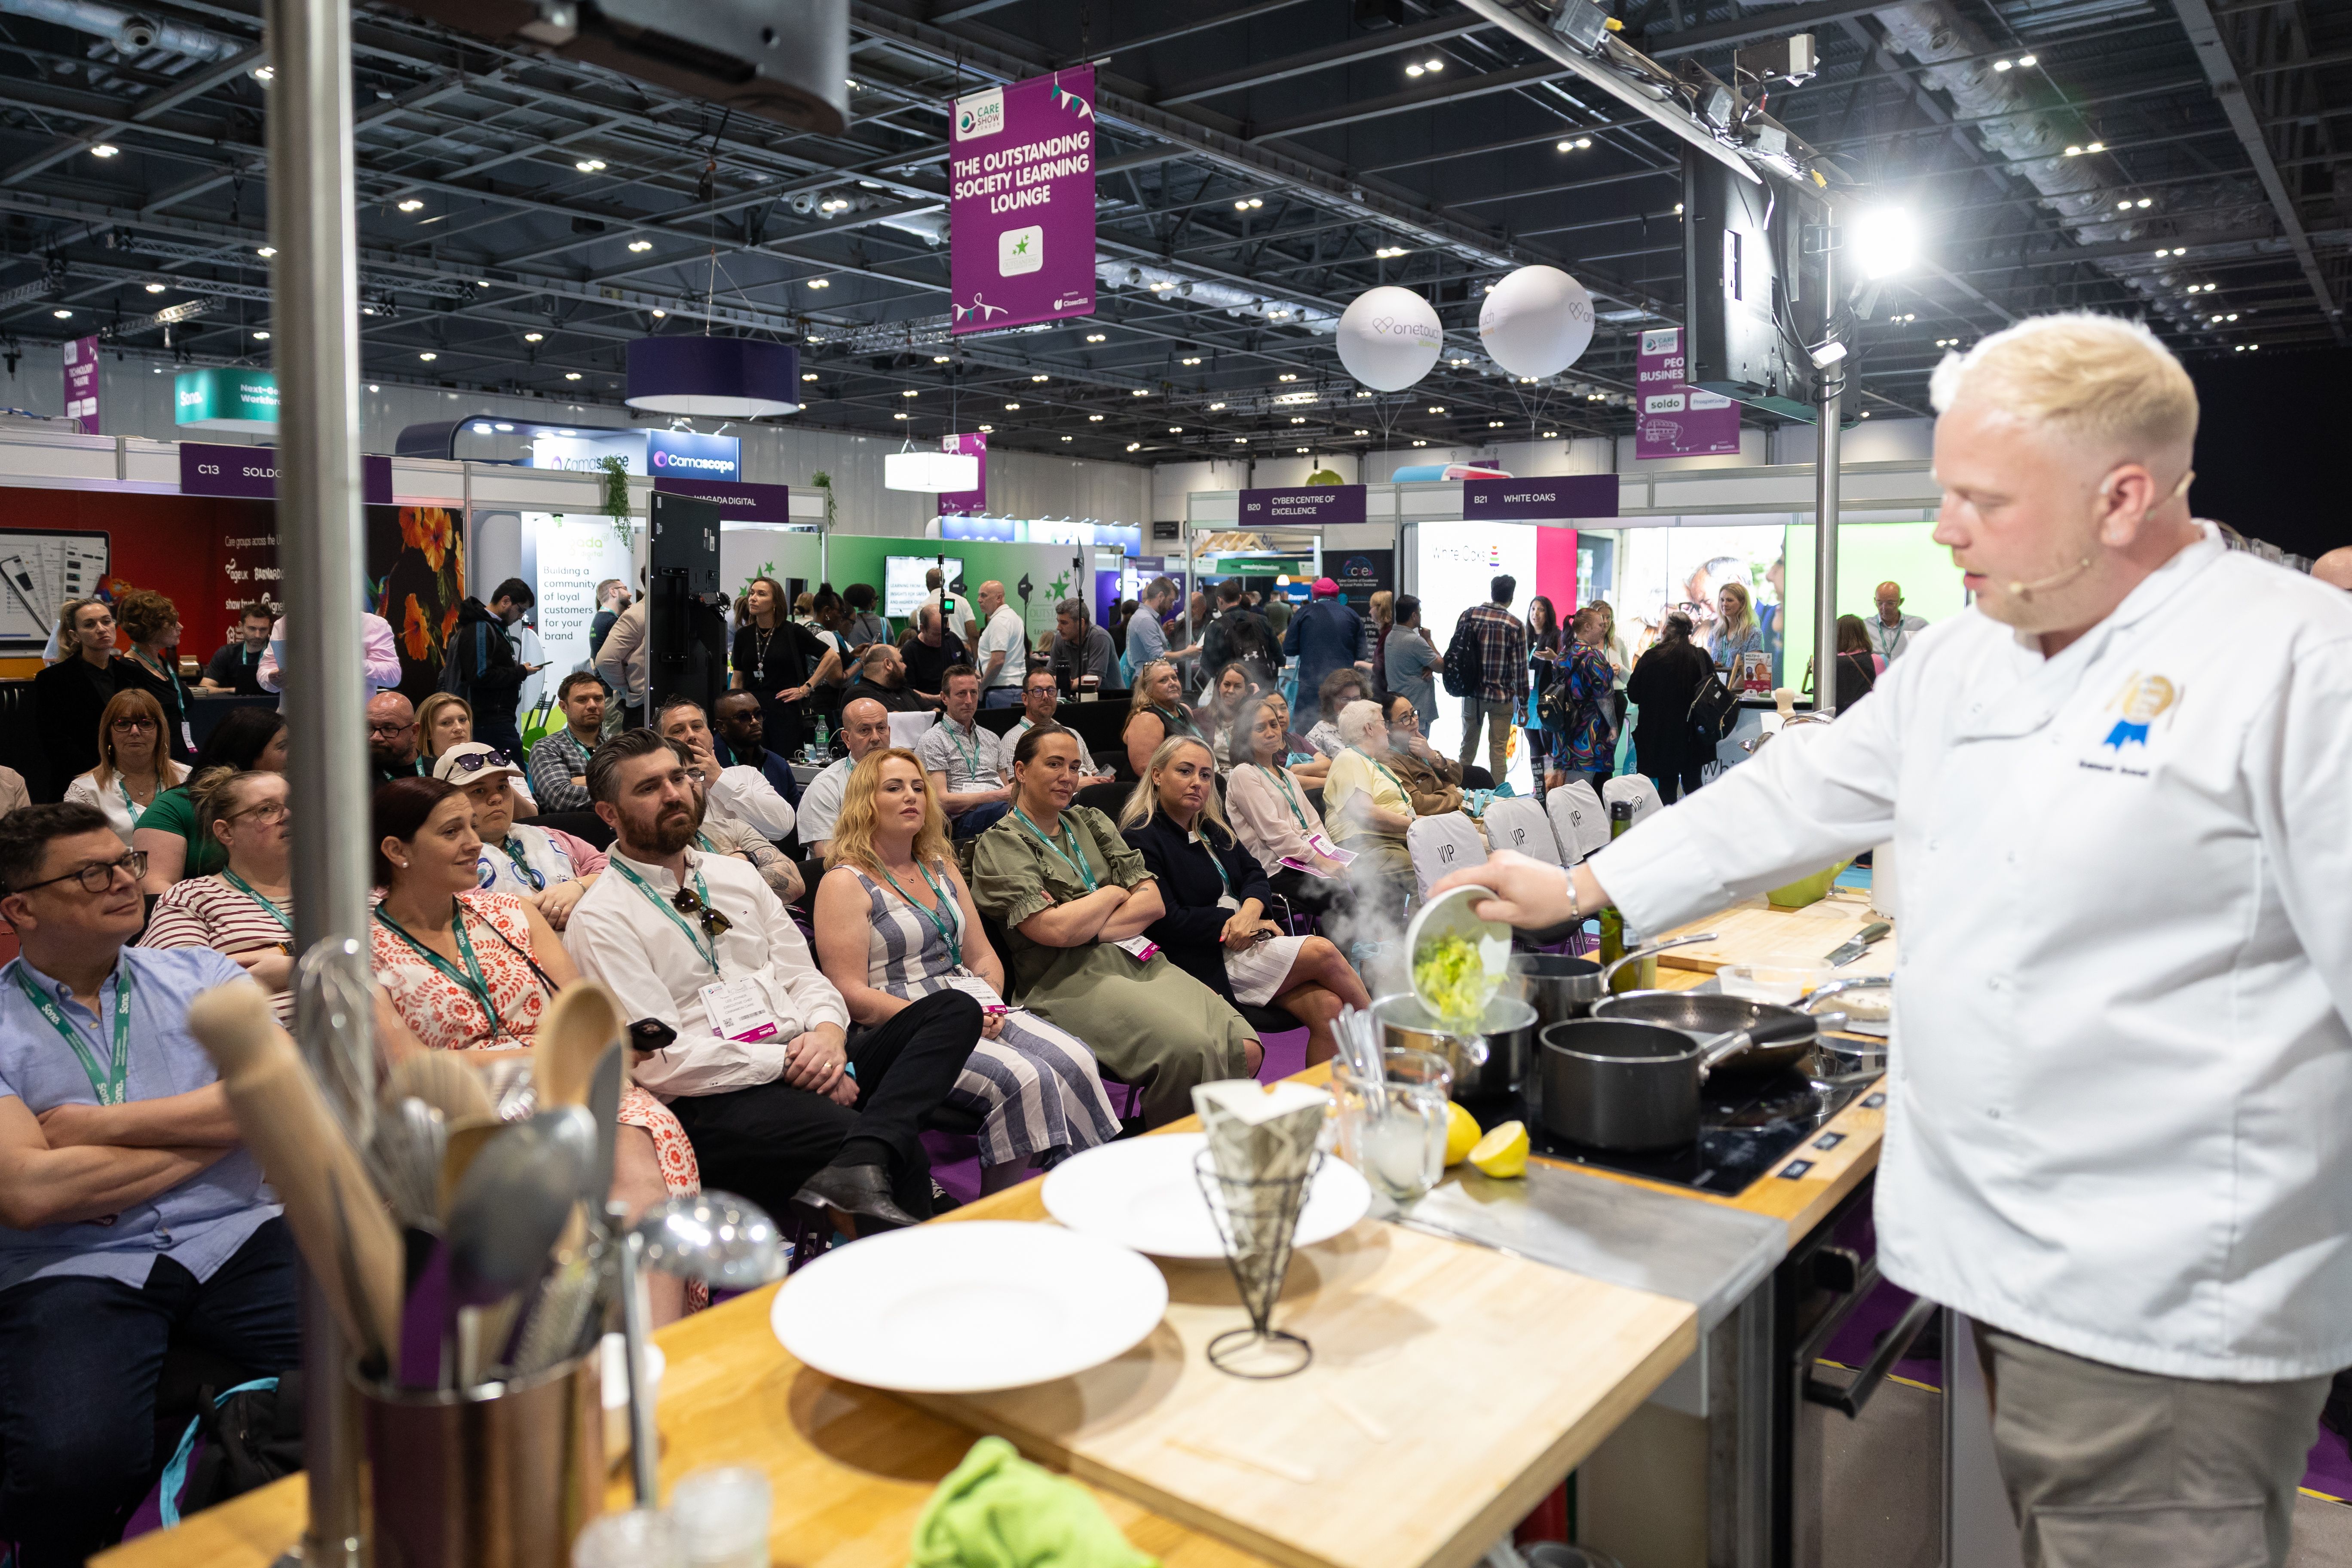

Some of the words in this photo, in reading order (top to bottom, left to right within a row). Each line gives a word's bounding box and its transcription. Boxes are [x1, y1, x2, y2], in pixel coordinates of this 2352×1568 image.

[977, 103, 999, 117] CARE
[978, 113, 999, 126] SHOW
[954, 157, 980, 178] THE
[983, 131, 1090, 171] OUTSTANDING
[955, 172, 1012, 199] SOCIETY
[1016, 154, 1090, 187] LEARNING
[991, 184, 1050, 214] LOUNGE
[69, 362, 93, 378] TECHNOLOGY
[1651, 399, 1680, 409] soldo
[198, 464, 220, 475] C13
[668, 454, 735, 474] Camascope
[729, 497, 756, 506] DIGITAL
[1295, 496, 1324, 504] CENTRE
[1504, 494, 1531, 502] WHITE
[1532, 493, 1556, 502] OAKS
[1272, 507, 1317, 515] EXCELLENCE
[225, 536, 235, 547] Care
[236, 537, 251, 549] groups
[252, 537, 266, 546] across
[1432, 544, 1459, 561] White
[1463, 545, 1485, 561] Oaks
[544, 566, 580, 576] Building
[544, 581, 596, 589] community
[226, 598, 240, 609] shaw
[545, 592, 554, 600] of
[557, 592, 579, 602] loyal
[545, 619, 558, 627] for
[561, 620, 582, 629] your
[545, 631, 573, 640] brand
[1631, 796, 1642, 812] VIP
[1568, 810, 1581, 827] VIP
[1510, 828, 1525, 846] VIP
[1046, 839, 1058, 851] Sona.
[1437, 844, 1455, 864] VIP
[928, 874, 939, 890] Sona.
[248, 891, 263, 903] Sona.
[639, 882, 655, 900] Sona.
[456, 928, 466, 947] Sona.
[943, 932, 953, 950] Sona.
[119, 992, 130, 1014] Sona.
[723, 1001, 743, 1009] EXECUTIVE
[42, 1004, 60, 1025] Sona.
[725, 1006, 744, 1014] CINNAMON
